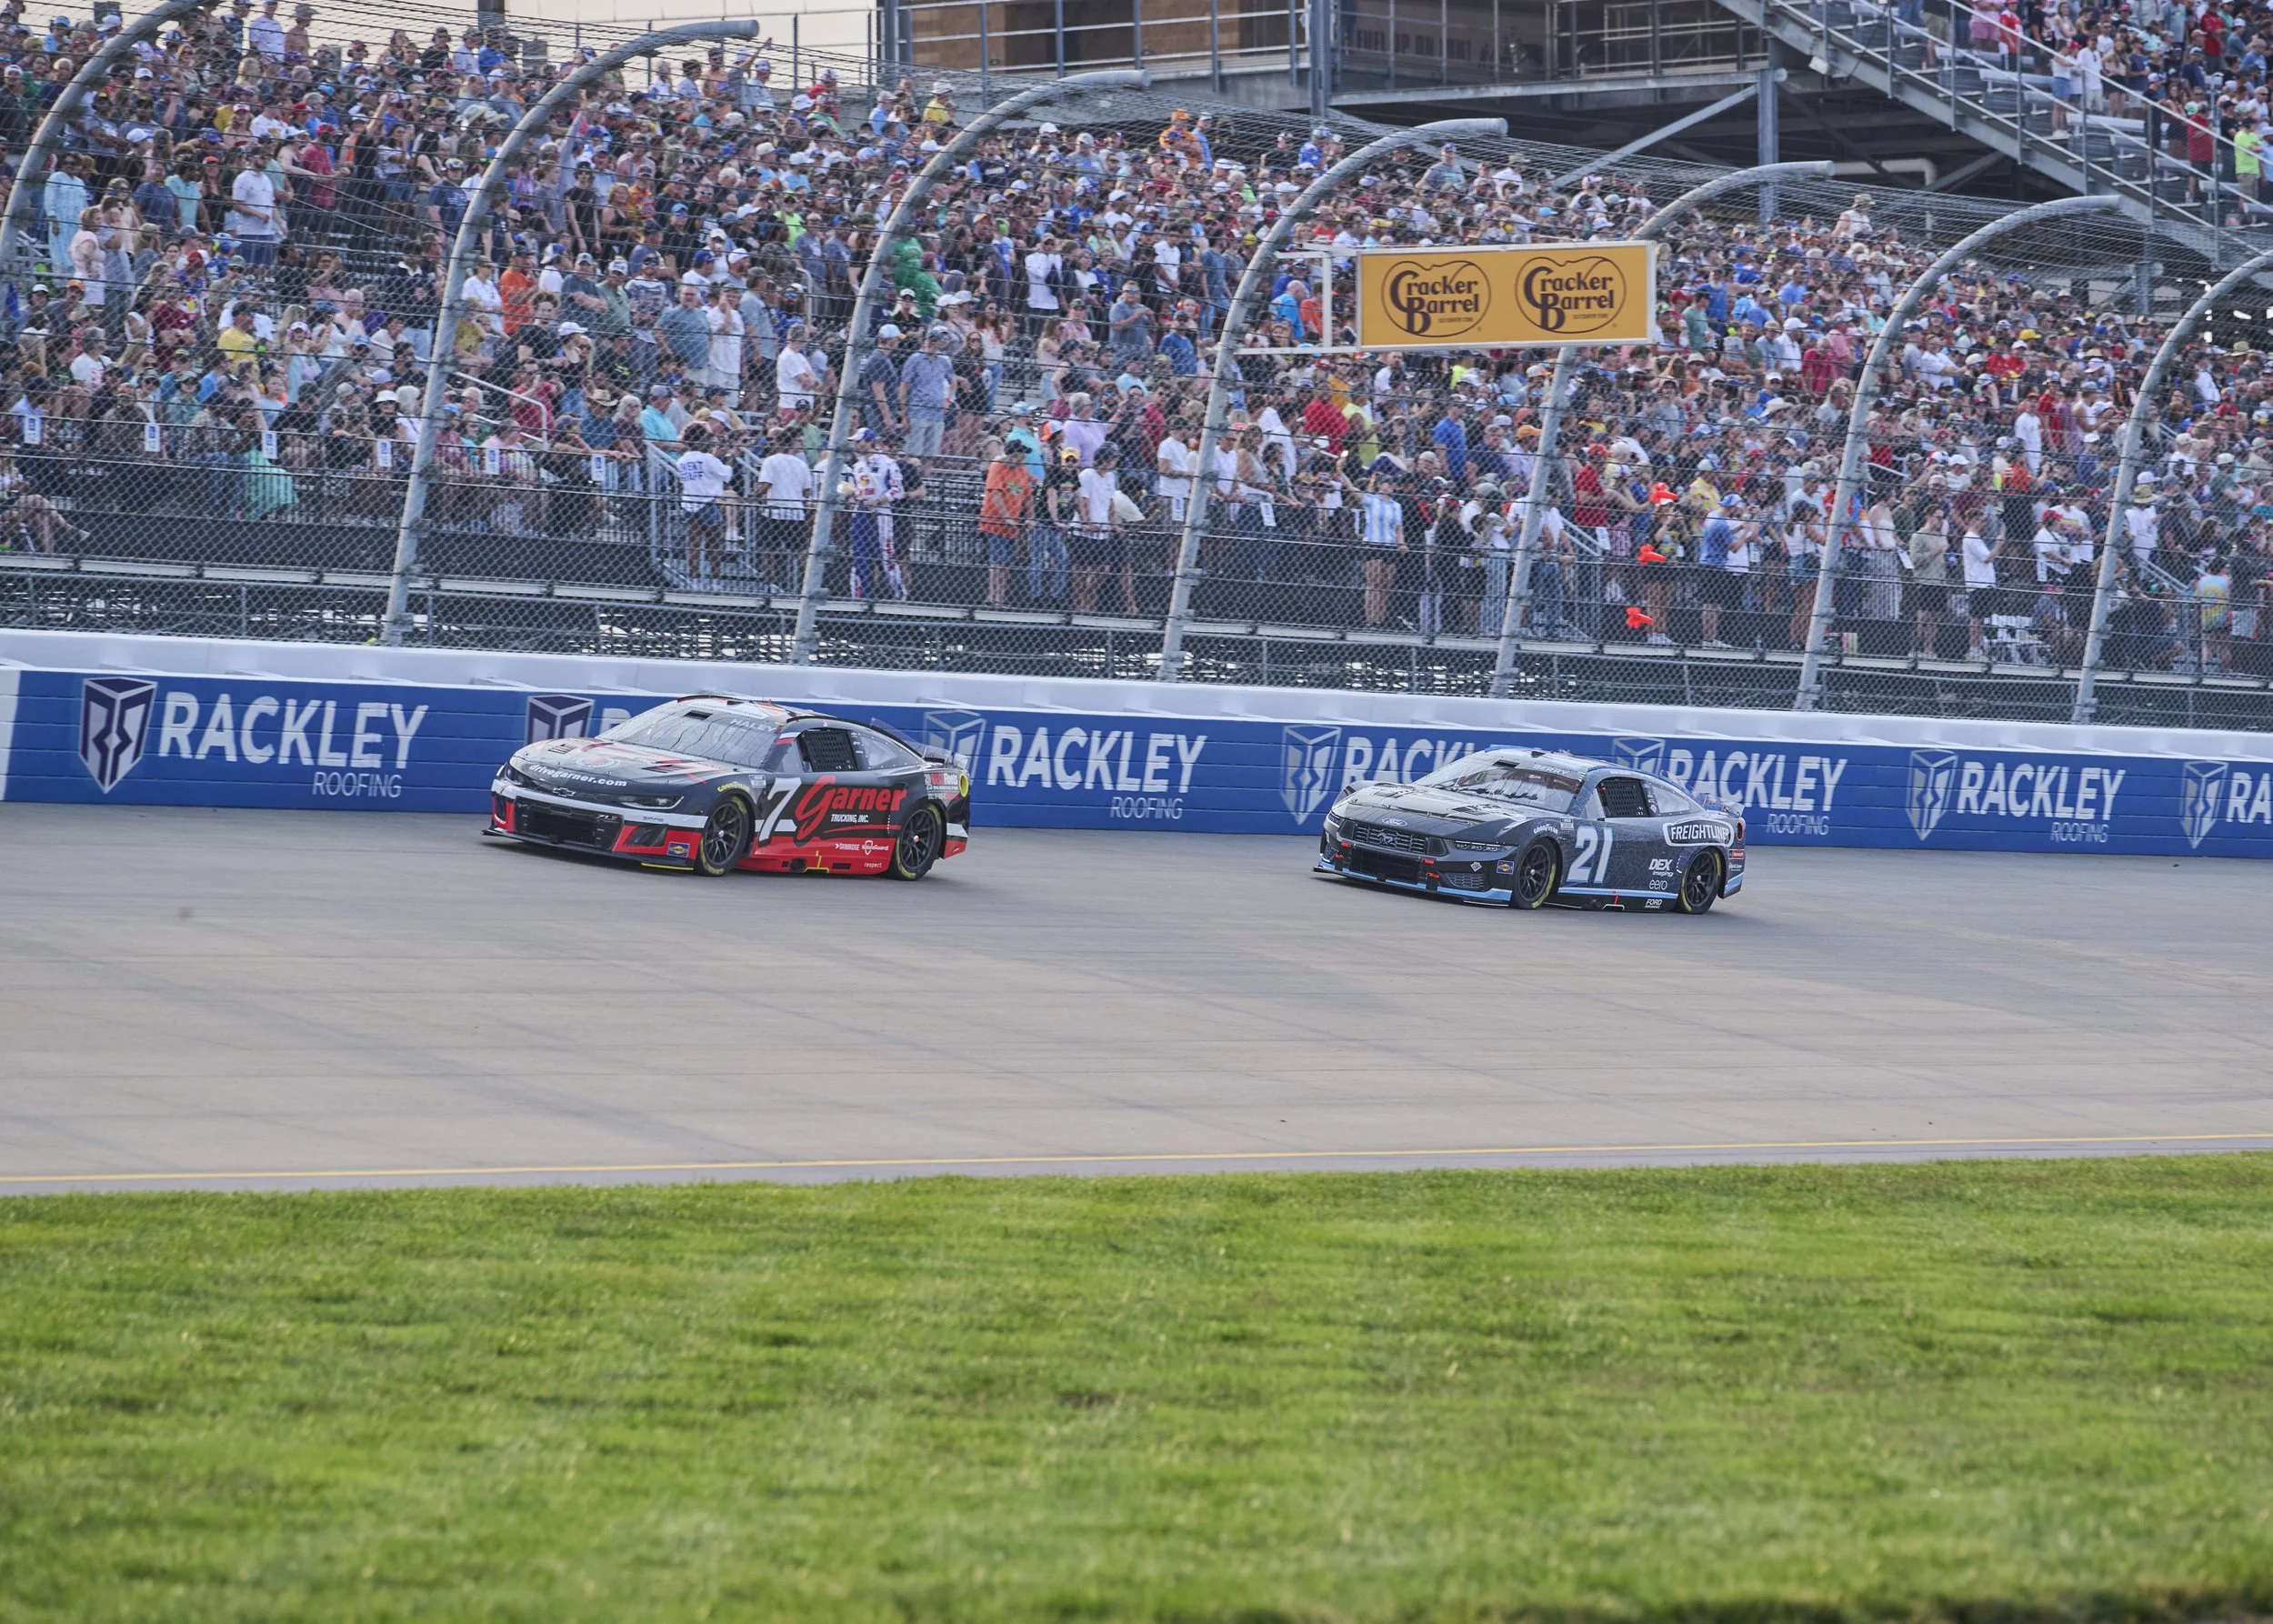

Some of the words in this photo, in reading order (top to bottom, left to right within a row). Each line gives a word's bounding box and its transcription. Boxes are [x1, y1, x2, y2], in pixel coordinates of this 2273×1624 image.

[1389, 269, 1479, 314] Cracker
[1523, 266, 1614, 309] Cracker
[1405, 293, 1480, 336] Barrel
[1539, 289, 1615, 331] Barrel
[158, 691, 429, 769] RACKLEY
[529, 763, 627, 787] drivegarner.com
[986, 725, 1208, 794] RACKLEY
[1669, 748, 1848, 812] RACKLEY
[311, 770, 404, 798] ROOFING
[1956, 760, 2127, 821] RACKLEY
[757, 777, 802, 843] 7
[795, 775, 908, 841] Garner
[830, 813, 857, 824] TRUCKING,
[1109, 796, 1184, 819] ROOFING
[1766, 813, 1830, 836] ROOFING
[1670, 824, 1730, 840] FREIGHTLINER
[2050, 821, 2108, 844] ROOFING
[1566, 826, 1614, 883] 21
[1648, 858, 1674, 870] DEX
[1648, 879, 1668, 890] eero
